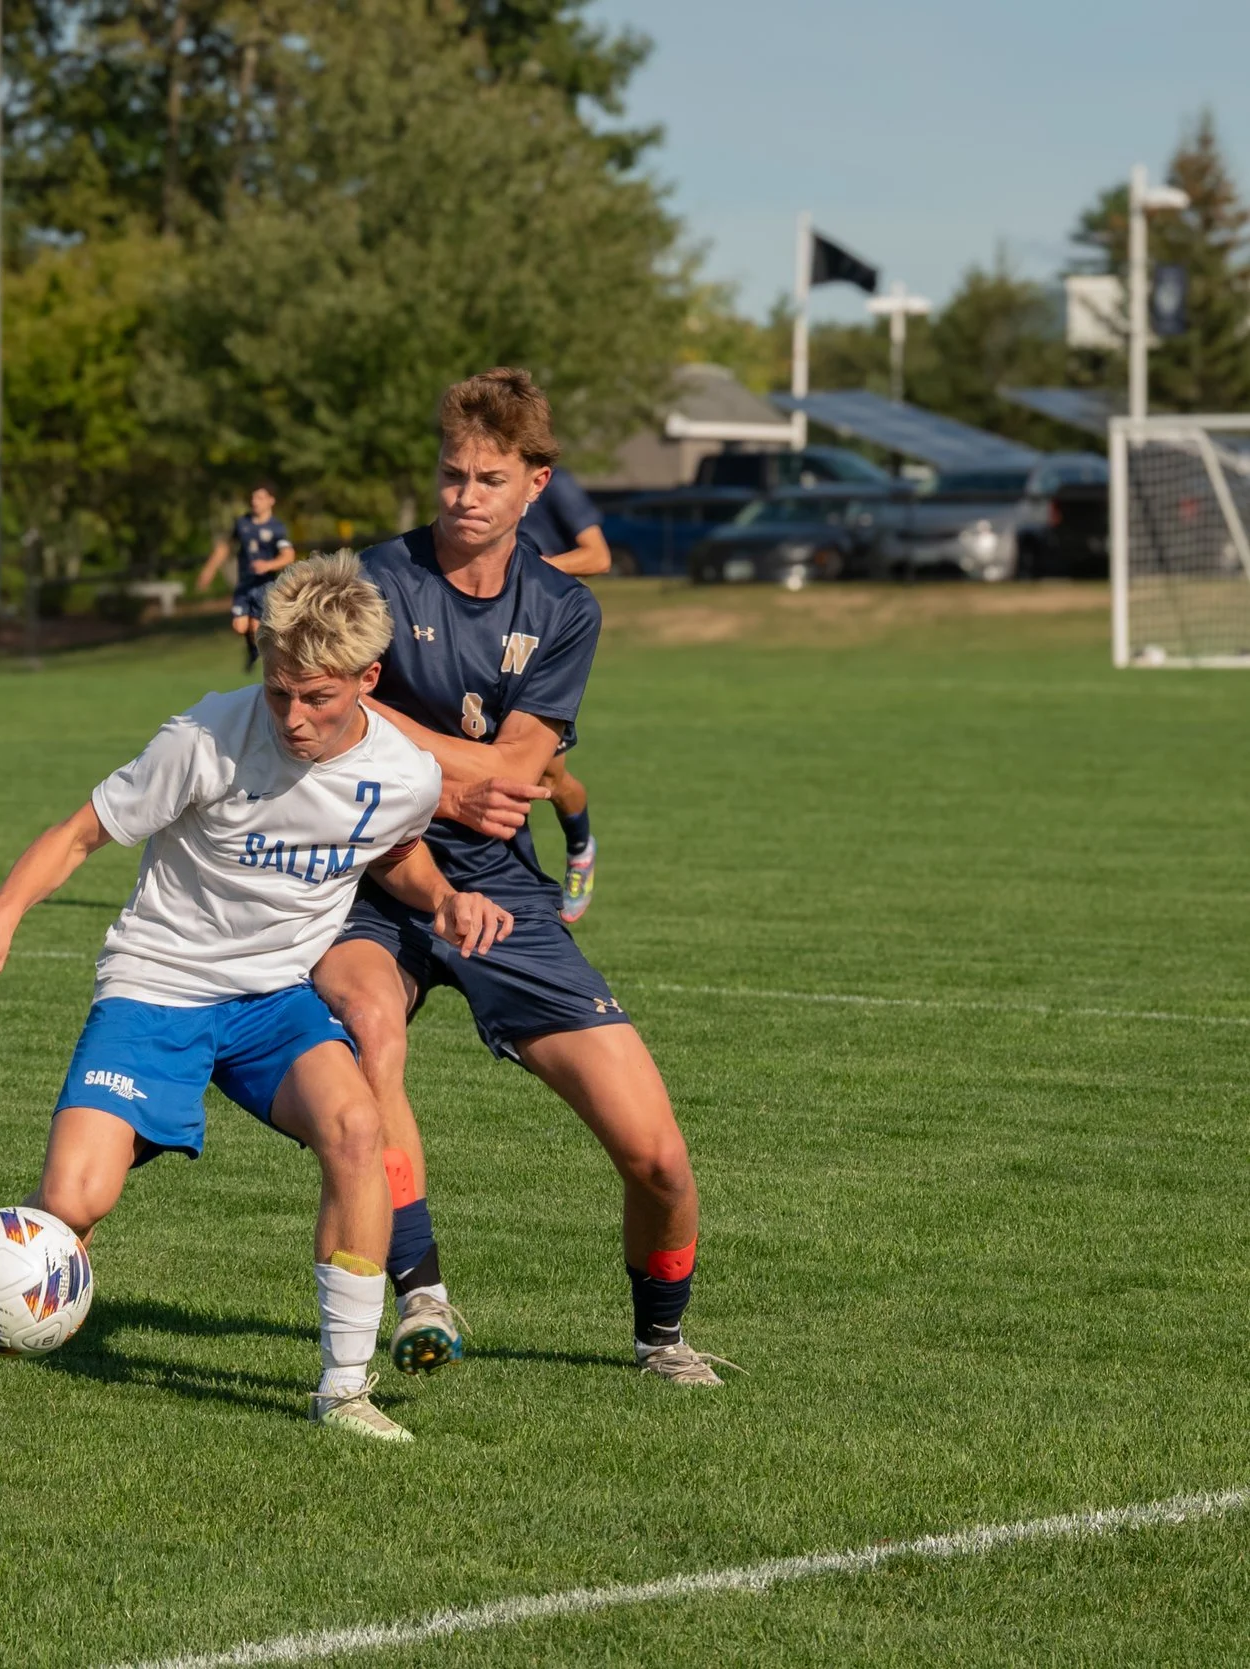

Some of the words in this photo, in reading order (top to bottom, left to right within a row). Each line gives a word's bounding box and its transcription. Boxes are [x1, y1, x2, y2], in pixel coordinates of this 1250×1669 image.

[461, 692, 487, 739] 8
[348, 780, 382, 844] 2
[238, 832, 356, 885] SALEM
[84, 1070, 135, 1092] SALEM
